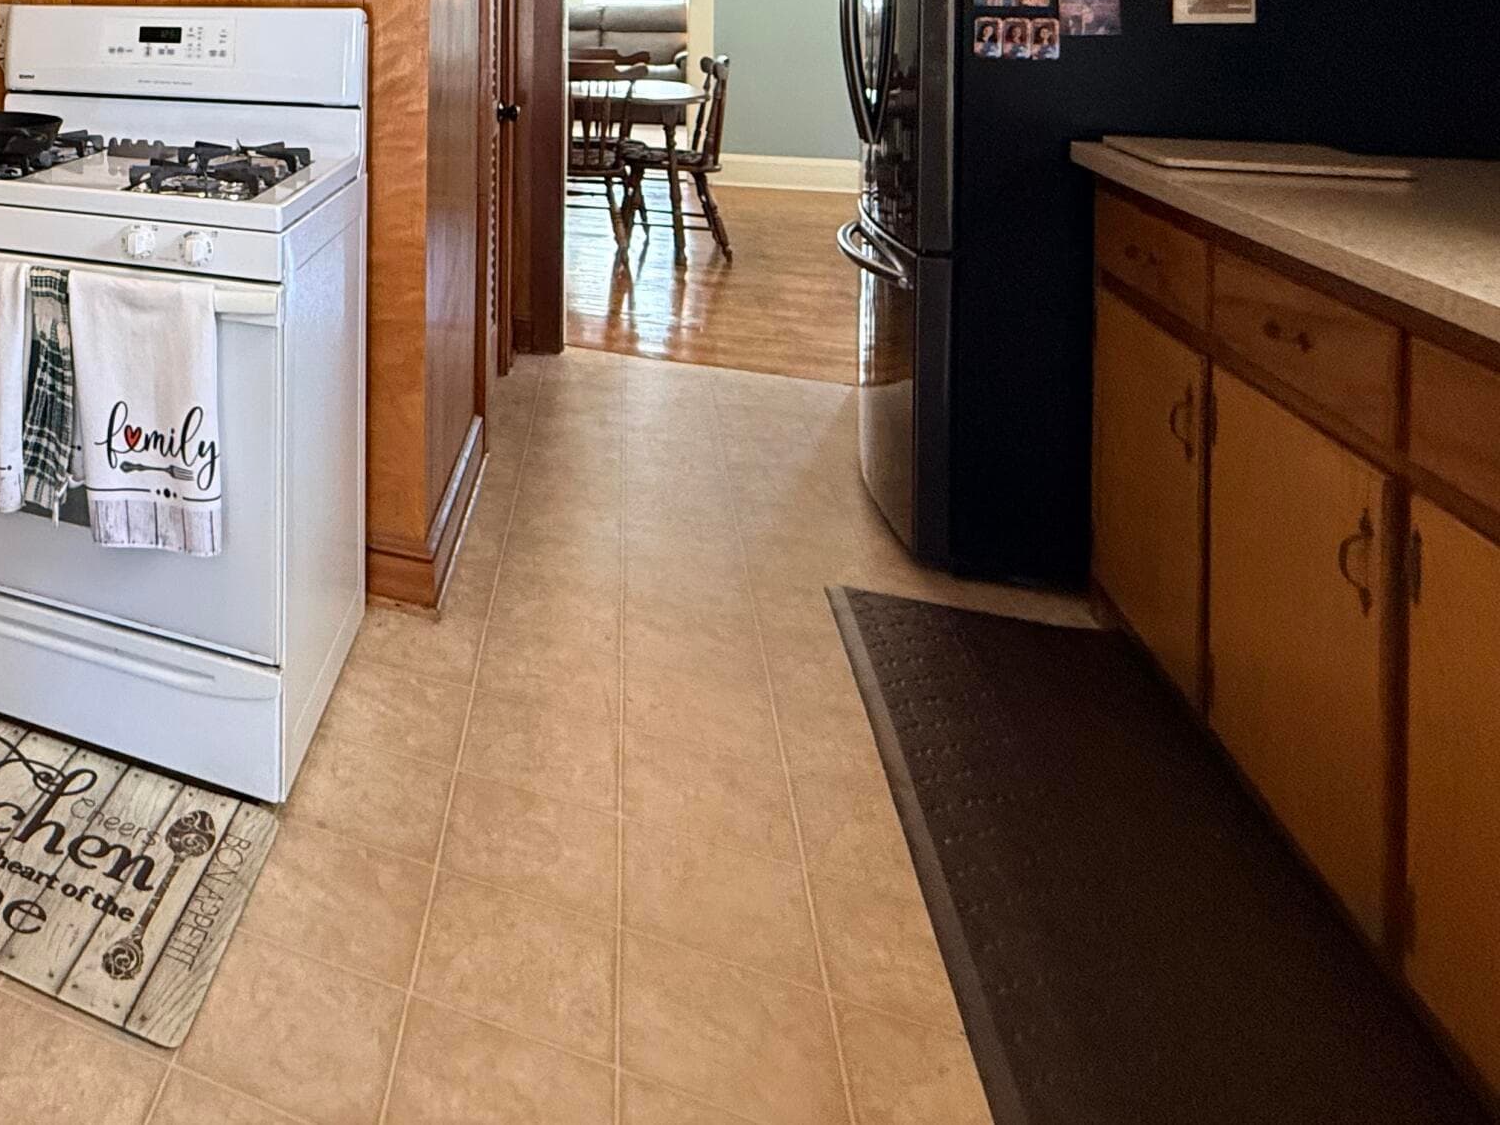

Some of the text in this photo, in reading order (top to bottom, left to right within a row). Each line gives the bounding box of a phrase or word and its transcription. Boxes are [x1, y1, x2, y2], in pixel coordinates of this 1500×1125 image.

[94, 401, 221, 491] fmily
[205, 833, 253, 887] BON
[61, 882, 94, 902] of
[92, 893, 135, 922] the
